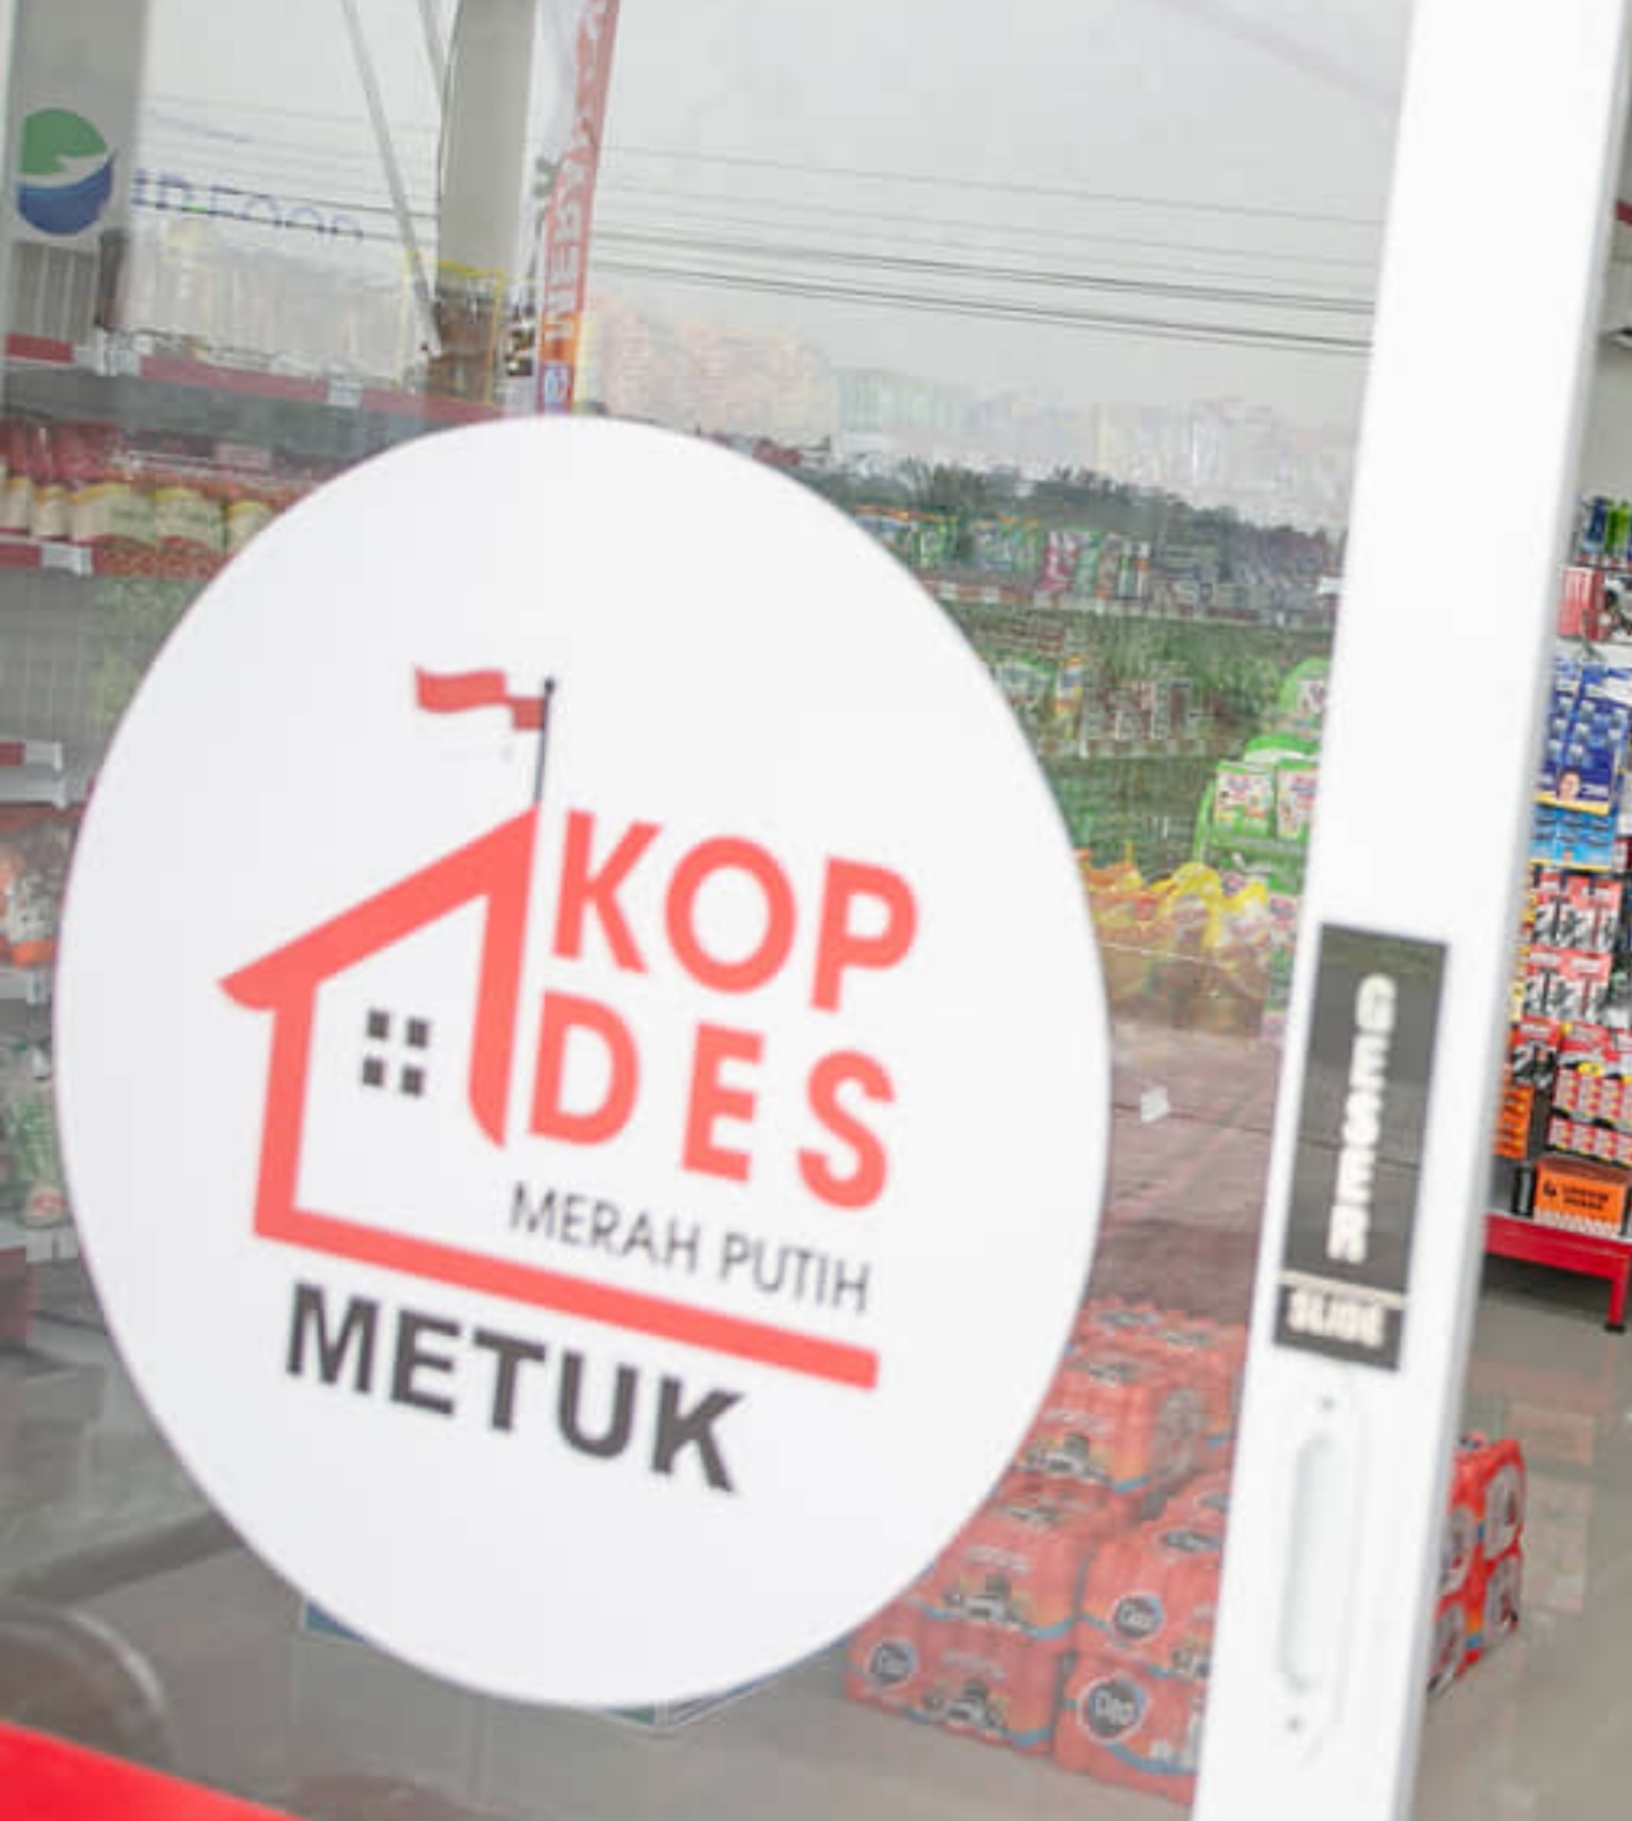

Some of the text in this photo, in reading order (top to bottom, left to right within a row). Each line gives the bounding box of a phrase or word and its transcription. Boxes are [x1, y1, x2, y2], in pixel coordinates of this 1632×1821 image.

[554, 809, 918, 1013] KOP
[530, 989, 896, 1209] DES
[1327, 973, 1396, 1264] GESER
[510, 1182, 872, 1315] MERAH PUTIH
[286, 1280, 744, 1493] METUK
